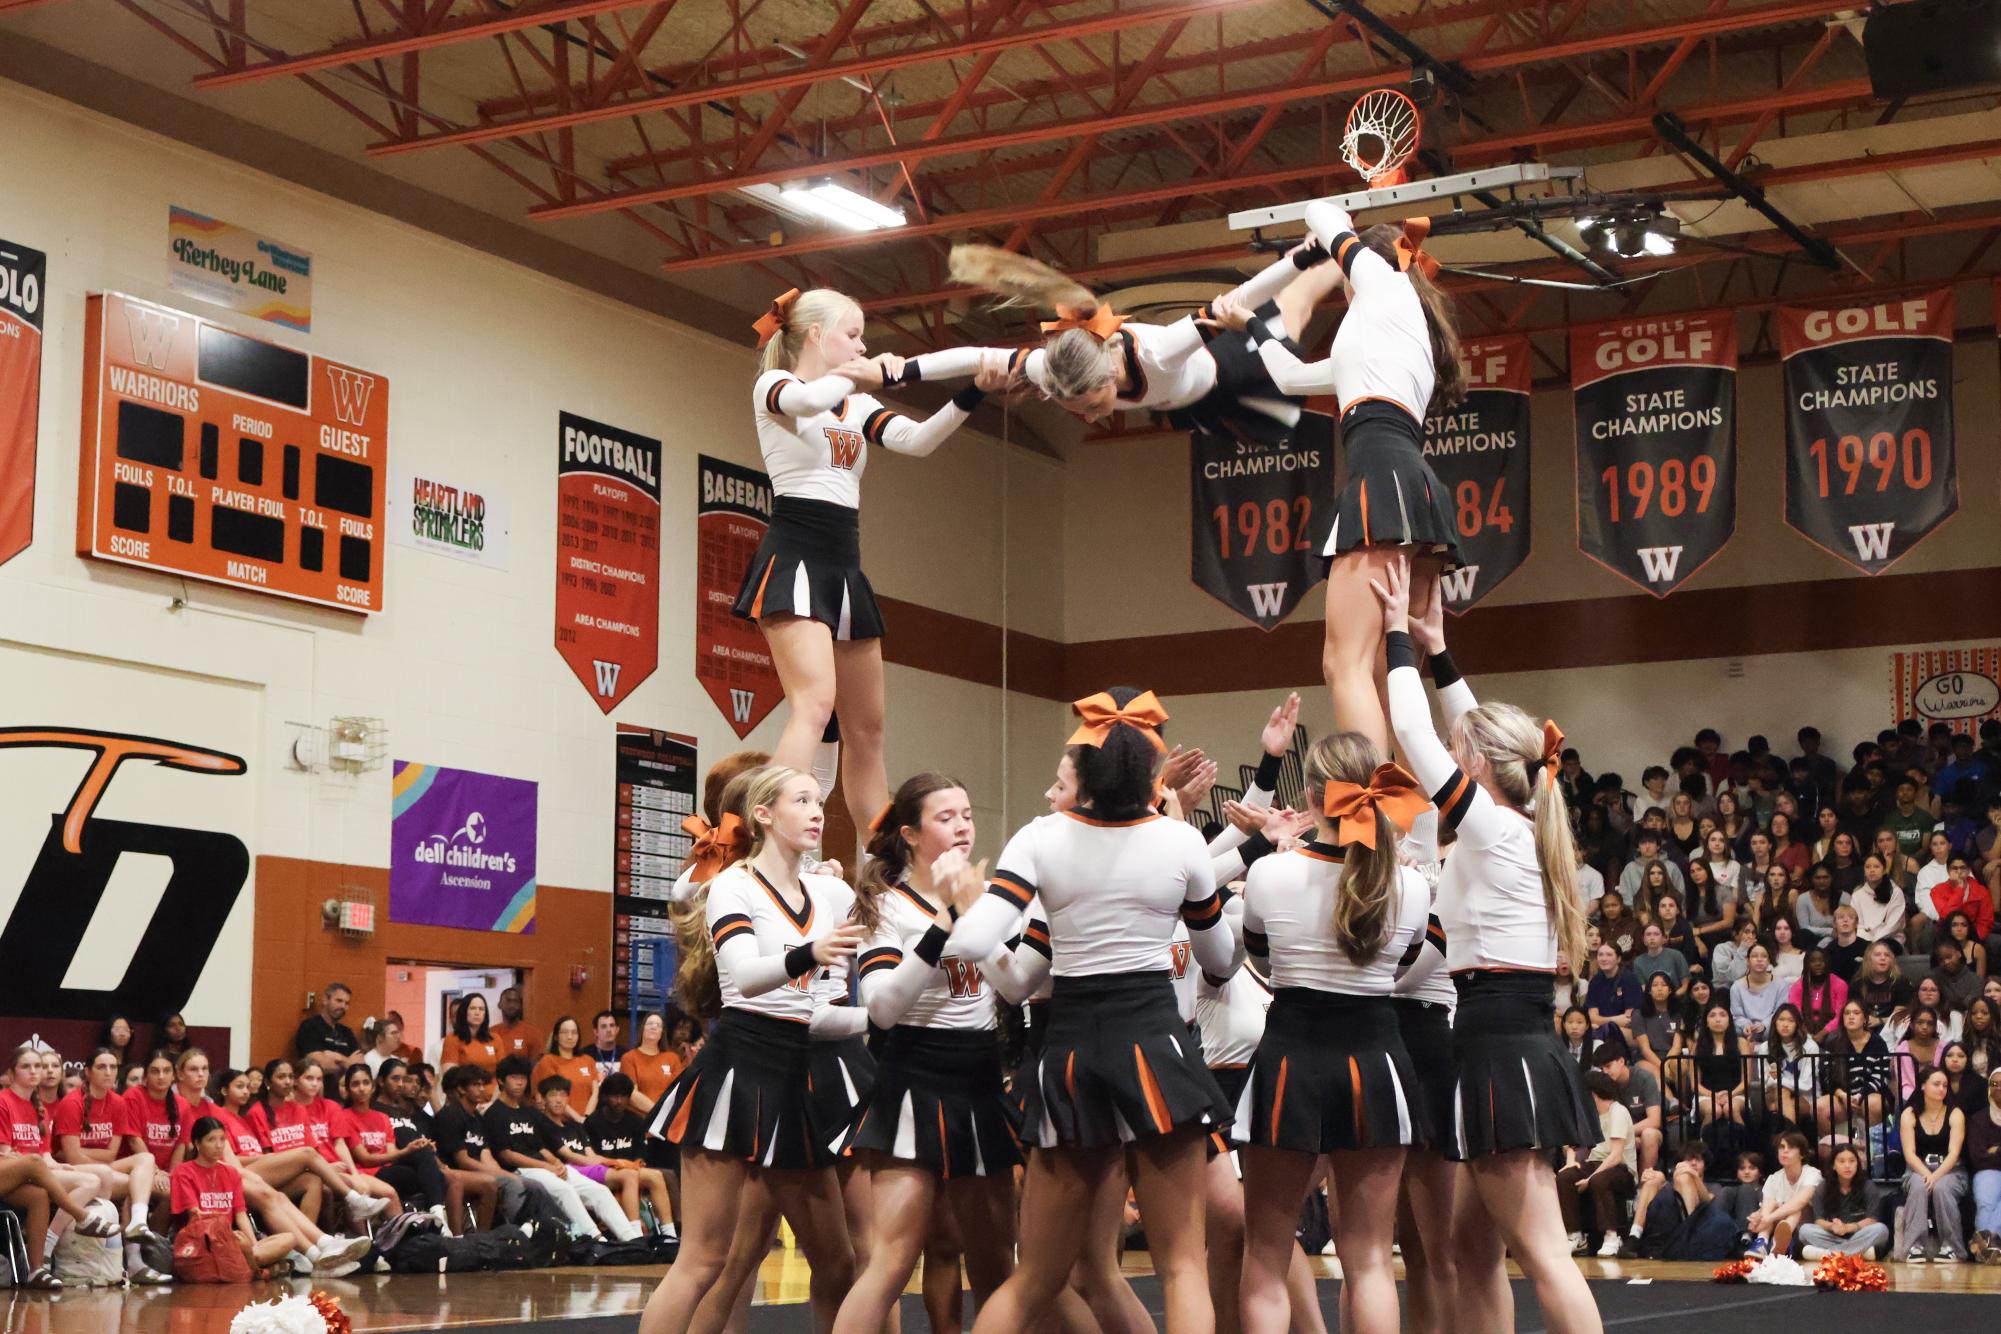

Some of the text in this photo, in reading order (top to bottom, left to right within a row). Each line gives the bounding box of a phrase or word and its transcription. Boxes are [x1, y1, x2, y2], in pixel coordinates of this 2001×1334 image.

[172, 238, 241, 283] Kerbey
[242, 261, 287, 294] Lane
[0, 264, 39, 314] OLO
[1621, 319, 1685, 338] GIRLS
[1804, 300, 1928, 341] GOLF
[1595, 330, 1713, 370] GOLF
[1463, 355, 1507, 384] LF
[1836, 361, 1899, 386] STATE
[110, 366, 200, 413] WARRIORS
[327, 365, 375, 427] W
[1626, 389, 1685, 413] STATE
[1799, 378, 1938, 412] CHAMPIONS
[232, 413, 273, 439] PERIOD
[1425, 412, 1480, 436] STATE
[1592, 406, 1722, 440] CHAMPIONS
[320, 424, 371, 459] GUEST
[564, 426, 656, 488] FOOTBALL
[823, 427, 864, 470] W
[1422, 430, 1517, 457] AMPIONS
[114, 462, 154, 488] FOULS
[1204, 450, 1320, 479] CHAMPIONS
[1810, 428, 1932, 498] 1990
[166, 475, 199, 499] T.O.L.
[211, 486, 287, 519] PLAYER FOUL
[414, 477, 485, 522] HEARTLAND
[593, 483, 629, 502] PLAYOFFS
[1602, 454, 1717, 523] 1989
[299, 507, 329, 529] T.O.L.
[1456, 477, 1514, 537] 84
[339, 517, 374, 540] FOULS
[413, 505, 484, 552] SPRINKLERS
[1213, 495, 1312, 559] 1982
[1848, 522, 1895, 561] W
[110, 535, 150, 560] SCORE
[1637, 545, 1683, 582] W
[227, 560, 267, 584] MATCH
[571, 556, 645, 584] DISTRICT CHAMPIONS
[1440, 565, 1480, 602] W
[336, 584, 371, 606] SCORE
[1246, 582, 1288, 618] W
[575, 613, 640, 638] AREA CHAMPIONS
[712, 644, 770, 666] AREA CHAMPIONS
[593, 660, 621, 698] W
[729, 688, 755, 723] W
[415, 841, 516, 873] dell children's
[440, 871, 491, 891] Ascension
